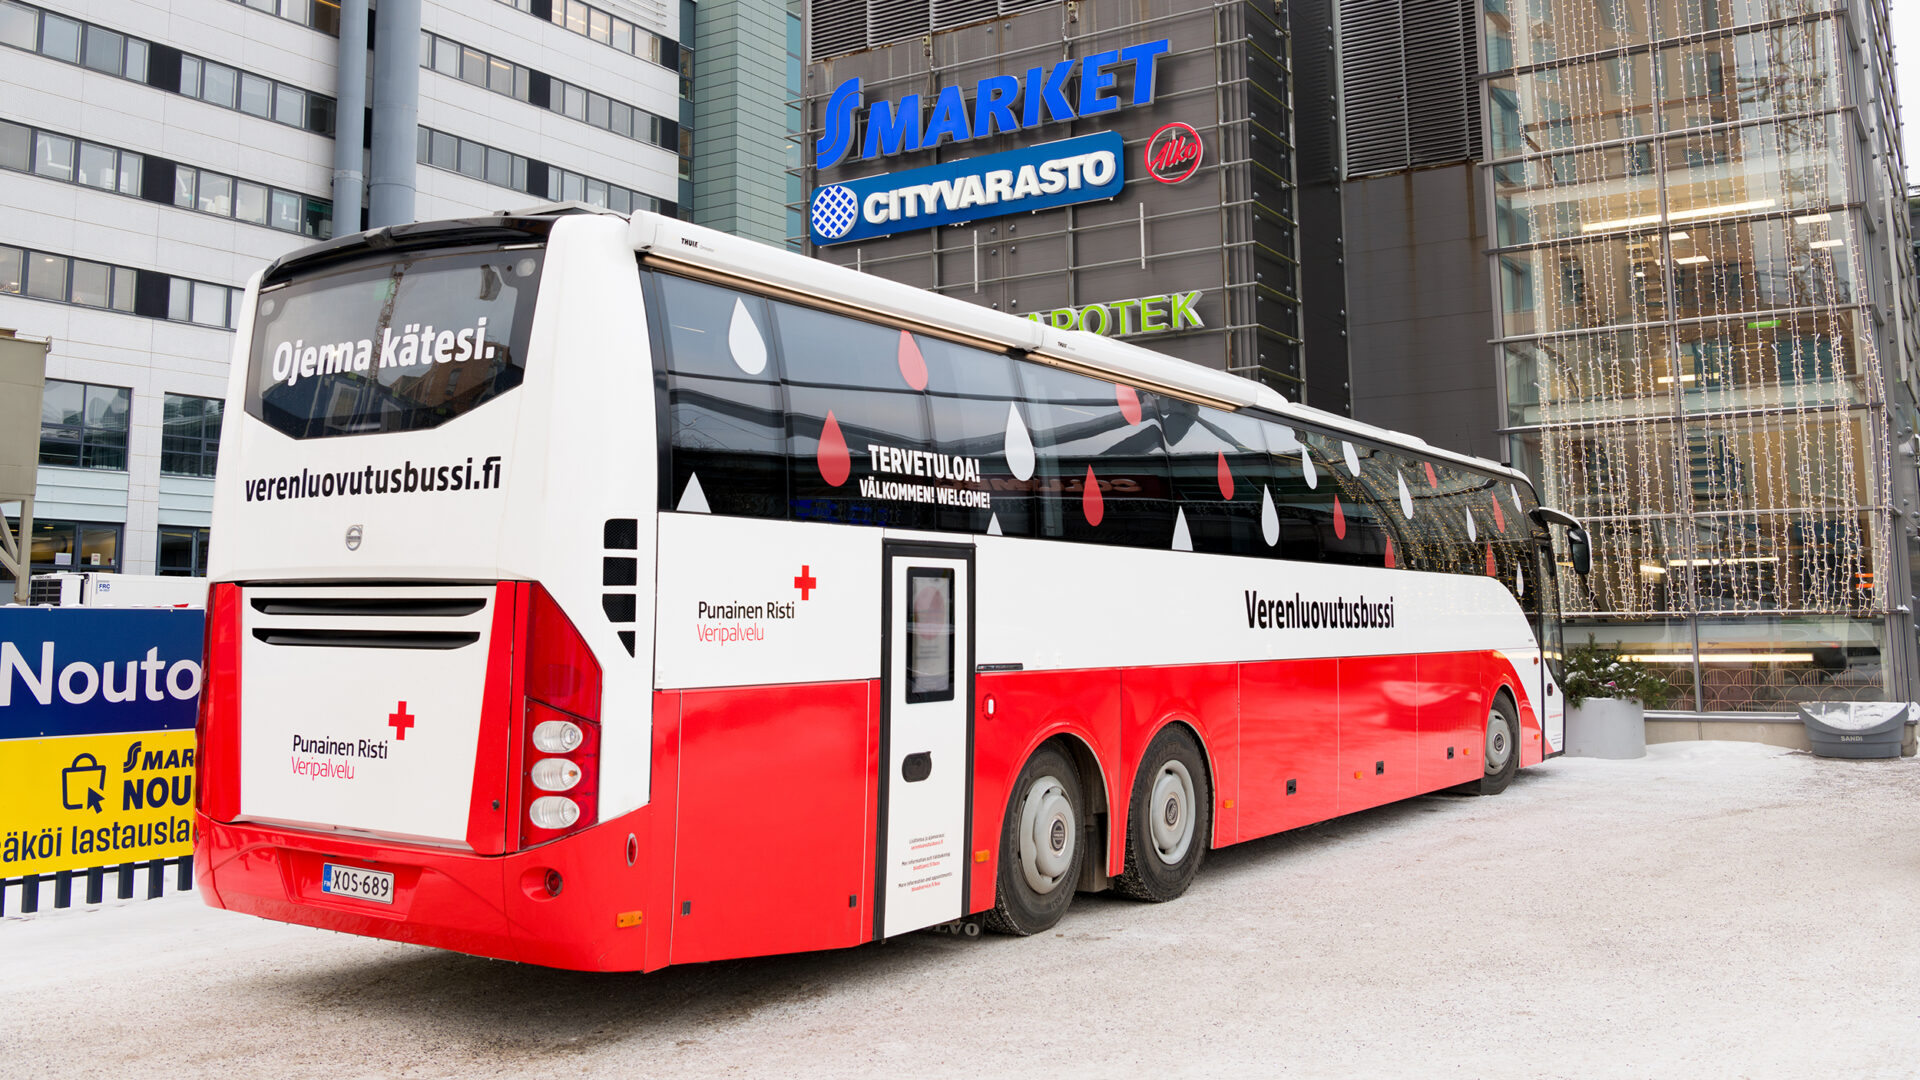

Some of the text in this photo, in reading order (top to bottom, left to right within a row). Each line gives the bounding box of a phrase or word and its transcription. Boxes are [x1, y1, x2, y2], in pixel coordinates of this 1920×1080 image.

[1150, 135, 1198, 170] Alko
[863, 150, 1116, 225] CITYVARASTO
[681, 237, 698, 248] THULE
[272, 316, 496, 387] Ojenna kätesi.
[245, 455, 502, 502] verenluovutusbussi.fi
[867, 444, 981, 483] TERVETULOA!
[859, 476, 991, 509] VÄLKOMMEN! WELCOME!
[698, 600, 795, 619] Punainen Risti
[1244, 590, 1395, 629] Verenluovutusbussi
[696, 622, 764, 647] Veripalvelu
[0, 640, 202, 707] Nouto
[292, 734, 388, 759] Punainen Risti
[291, 756, 355, 781] Veripalvelu
[122, 775, 192, 811] NOU
[0, 816, 190, 863] äköi lastausla
[333, 869, 389, 897] XOS-689
